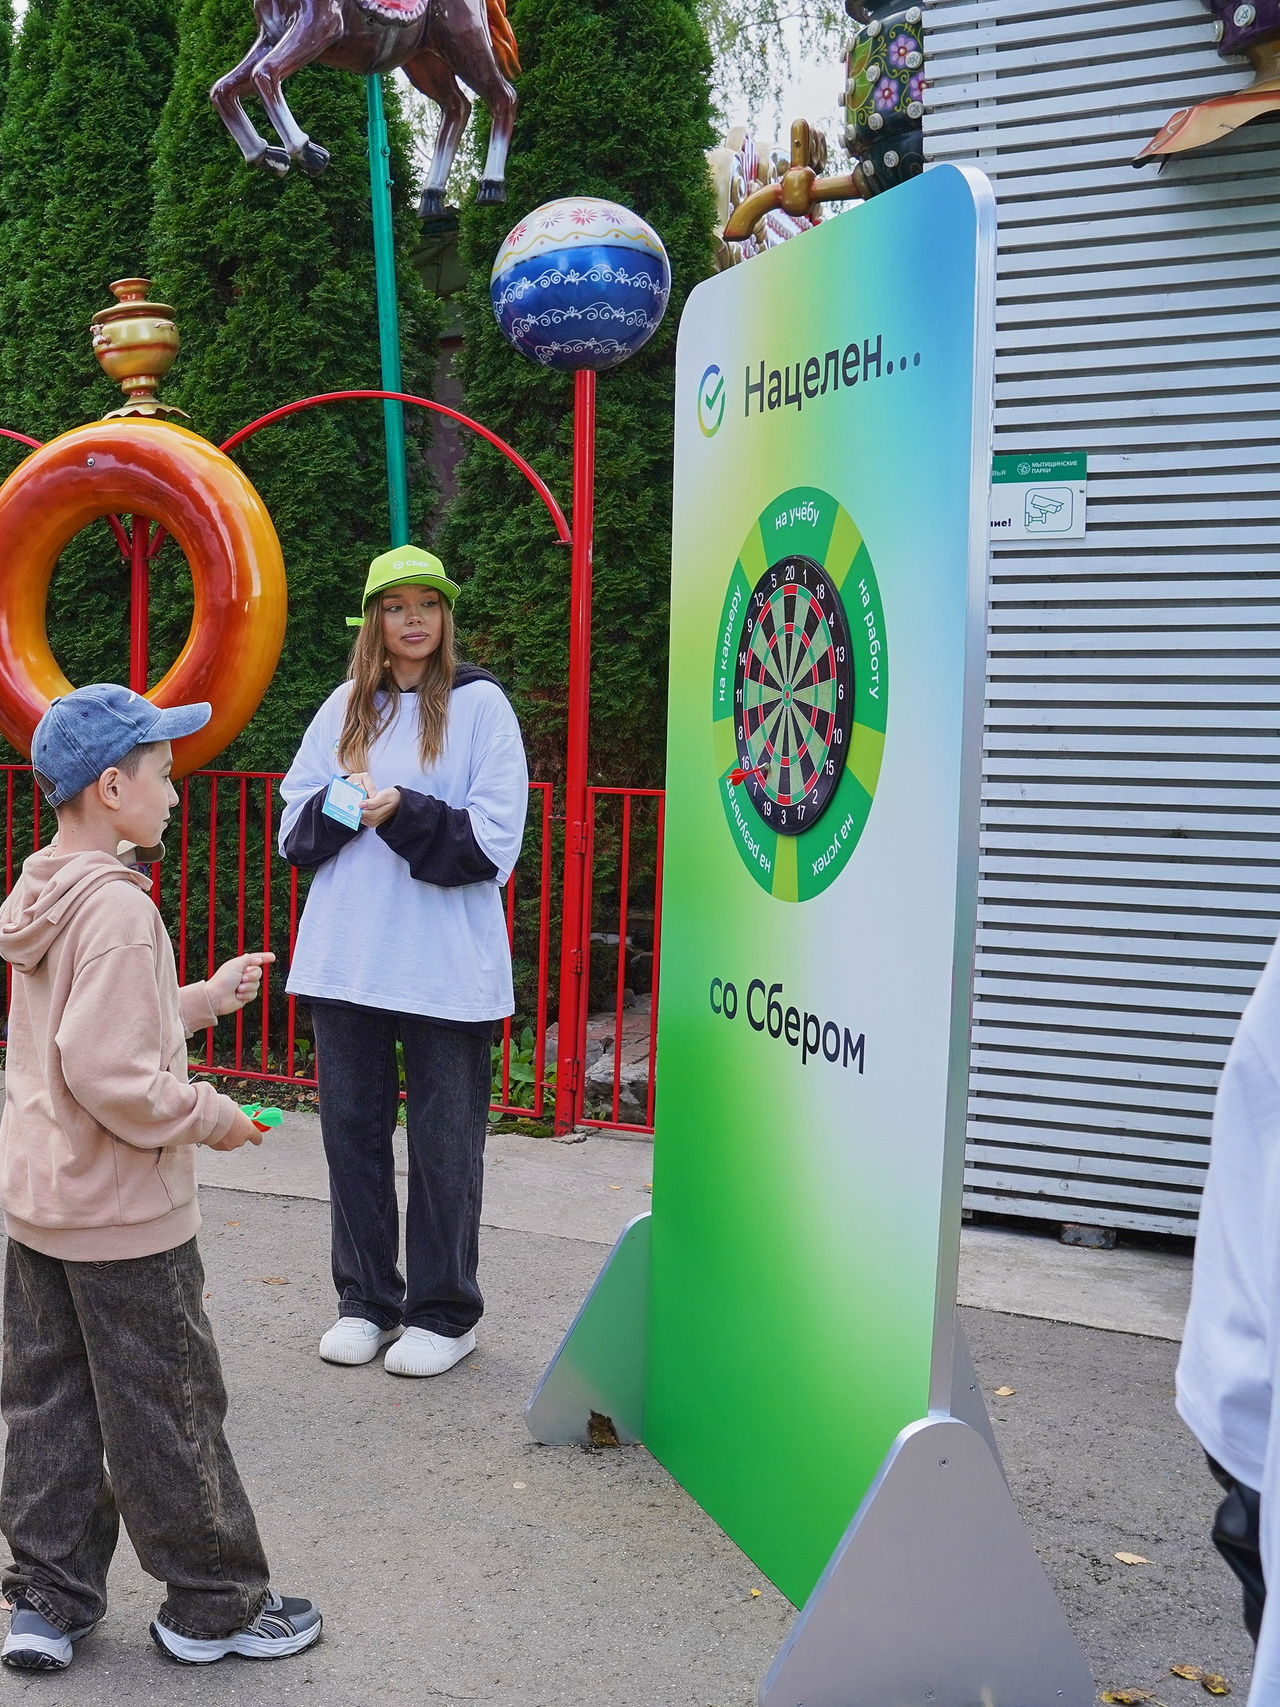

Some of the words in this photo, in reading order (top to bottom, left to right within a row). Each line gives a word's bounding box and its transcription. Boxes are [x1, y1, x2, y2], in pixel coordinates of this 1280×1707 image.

[744, 334, 921, 418] Нацелен...
[1031, 460, 1078, 468] МЫТИЩИНСКИЕ
[775, 511, 788, 531] на
[789, 501, 820, 528] учёбу
[771, 573, 777, 588] 5
[785, 565, 795, 581] 20
[802, 569, 807, 584] 1
[816, 584, 825, 599] 18
[858, 578, 870, 608] на
[754, 592, 764, 607] 12
[747, 618, 753, 633] 9
[828, 612, 835, 628] 4
[721, 585, 742, 671] карьеру
[738, 652, 747, 666] 14
[835, 646, 845, 662] 13
[863, 611, 881, 700] работу
[719, 677, 727, 702] на
[736, 688, 743, 703] 11
[838, 685, 844, 700] 6
[738, 726, 743, 740] 8
[833, 729, 843, 744] 10
[741, 756, 750, 771] 16
[825, 760, 835, 776] 15
[753, 782, 758, 796] 7
[812, 789, 818, 804] 2
[763, 801, 772, 816] 19
[796, 805, 806, 821] 17
[726, 779, 760, 860] результат
[781, 810, 787, 825] 3
[840, 813, 854, 838] на
[759, 853, 771, 874] на
[812, 835, 842, 877] успех
[709, 976, 738, 1020] со
[746, 978, 866, 1075] Сбером
